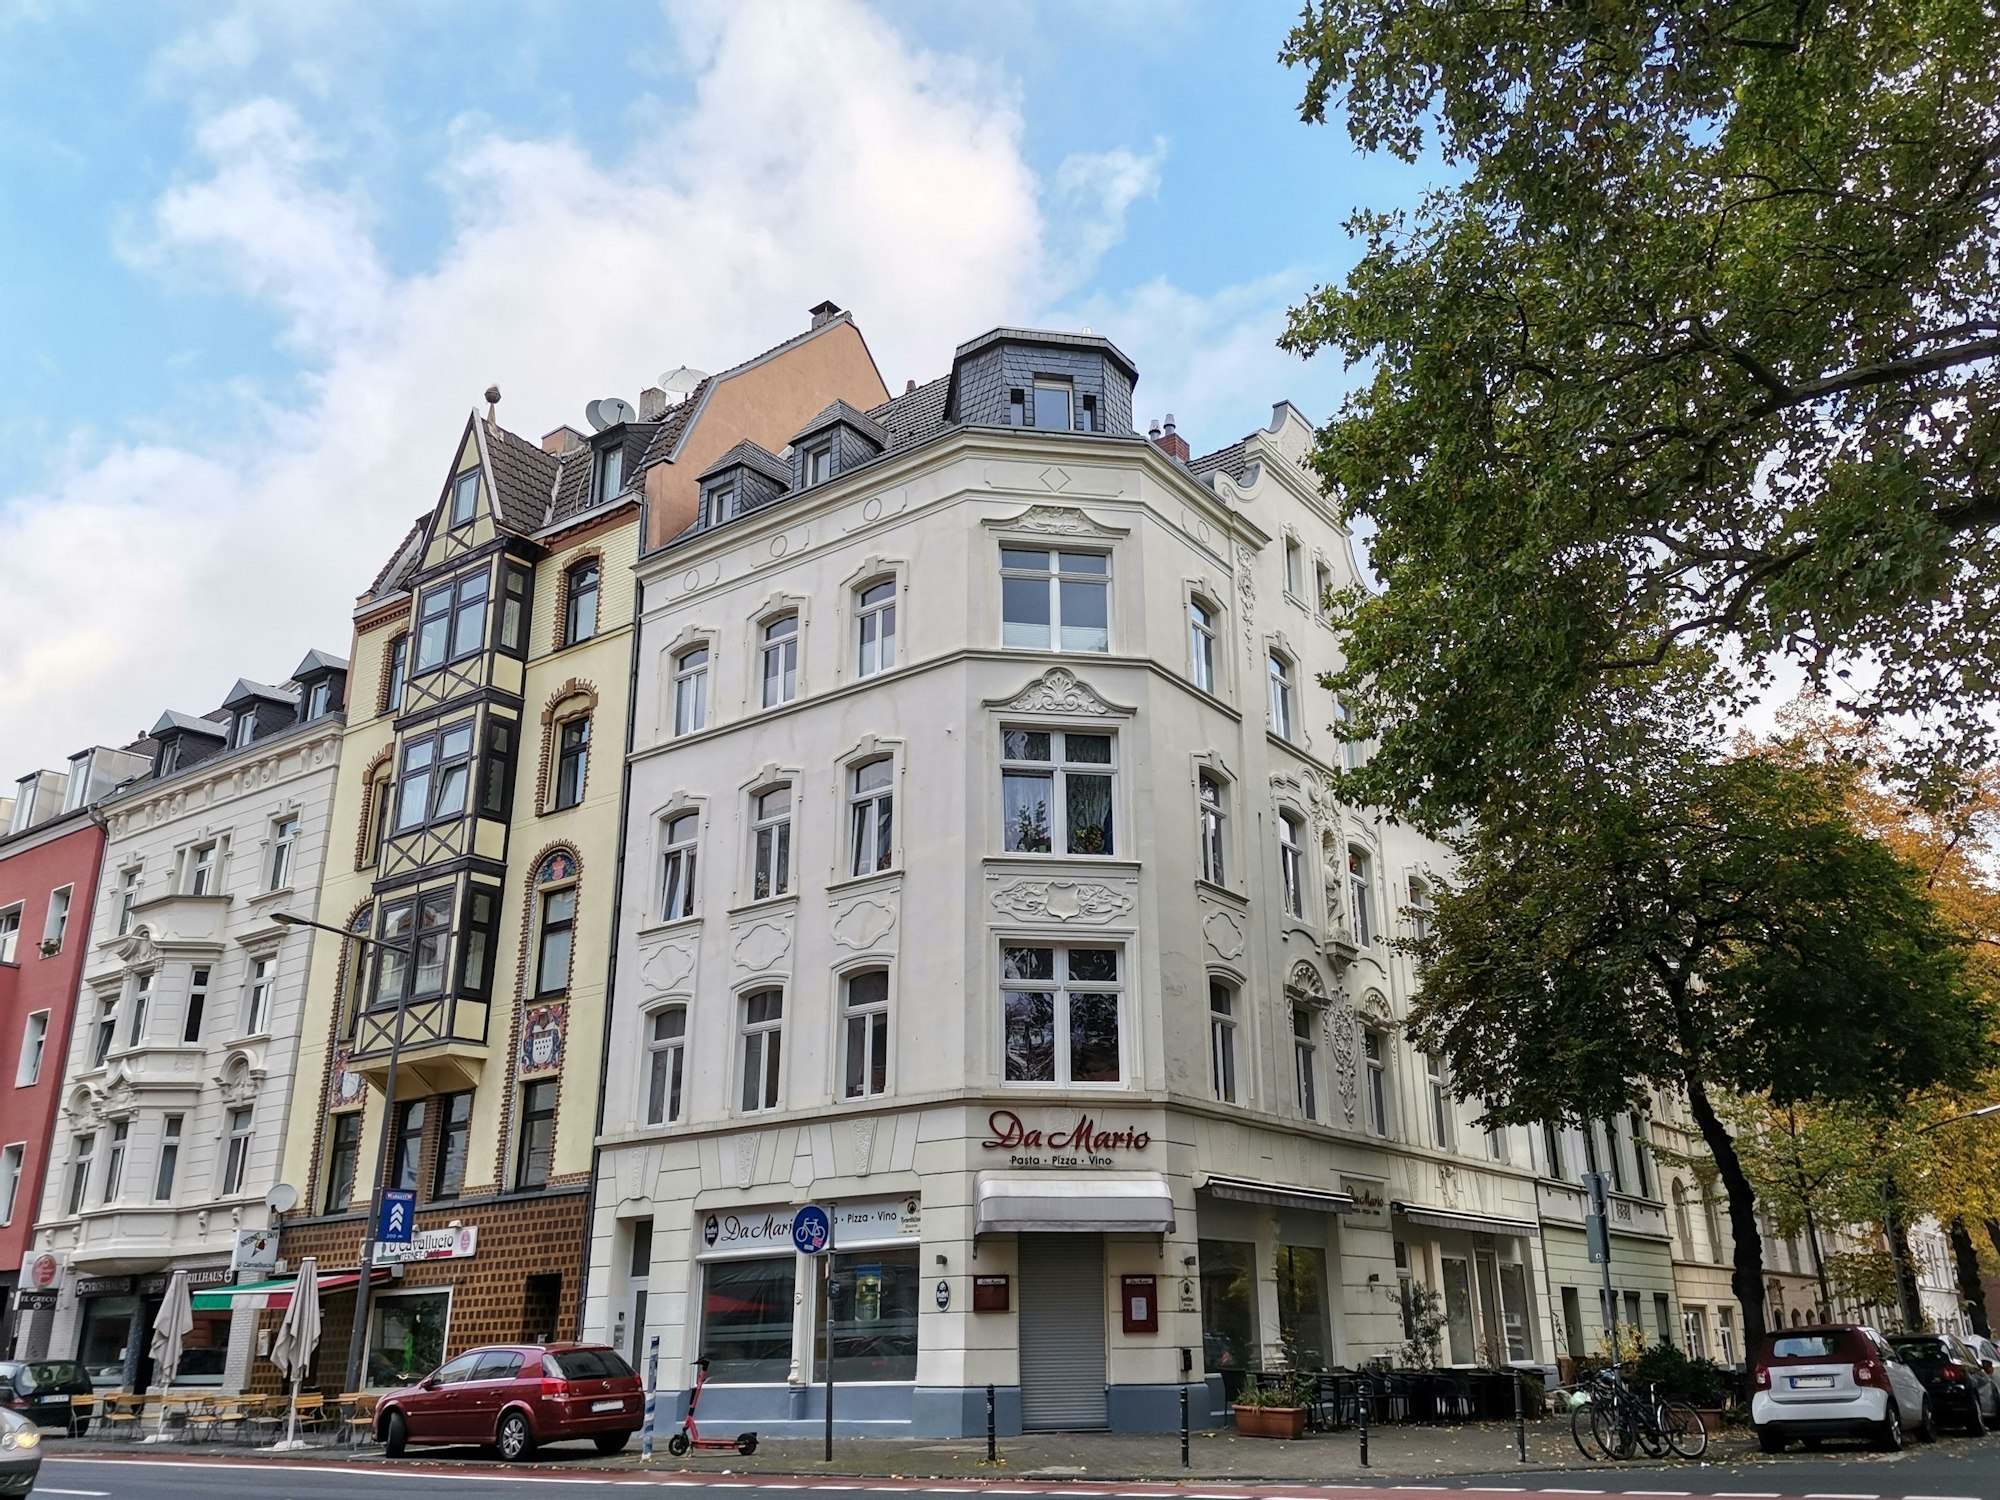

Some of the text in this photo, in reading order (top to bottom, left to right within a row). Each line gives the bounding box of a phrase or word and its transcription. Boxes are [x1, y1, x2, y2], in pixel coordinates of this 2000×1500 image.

[982, 1110, 1151, 1154] Da Mario
[1011, 1155, 1112, 1165] Pasta Pizza Vino
[847, 1213, 868, 1225] Pizza
[878, 1210, 897, 1221] Vino
[721, 1213, 794, 1241] Da Mari
[399, 1233, 454, 1252] Cavallucio
[185, 1270, 223, 1283] RILLHAUS
